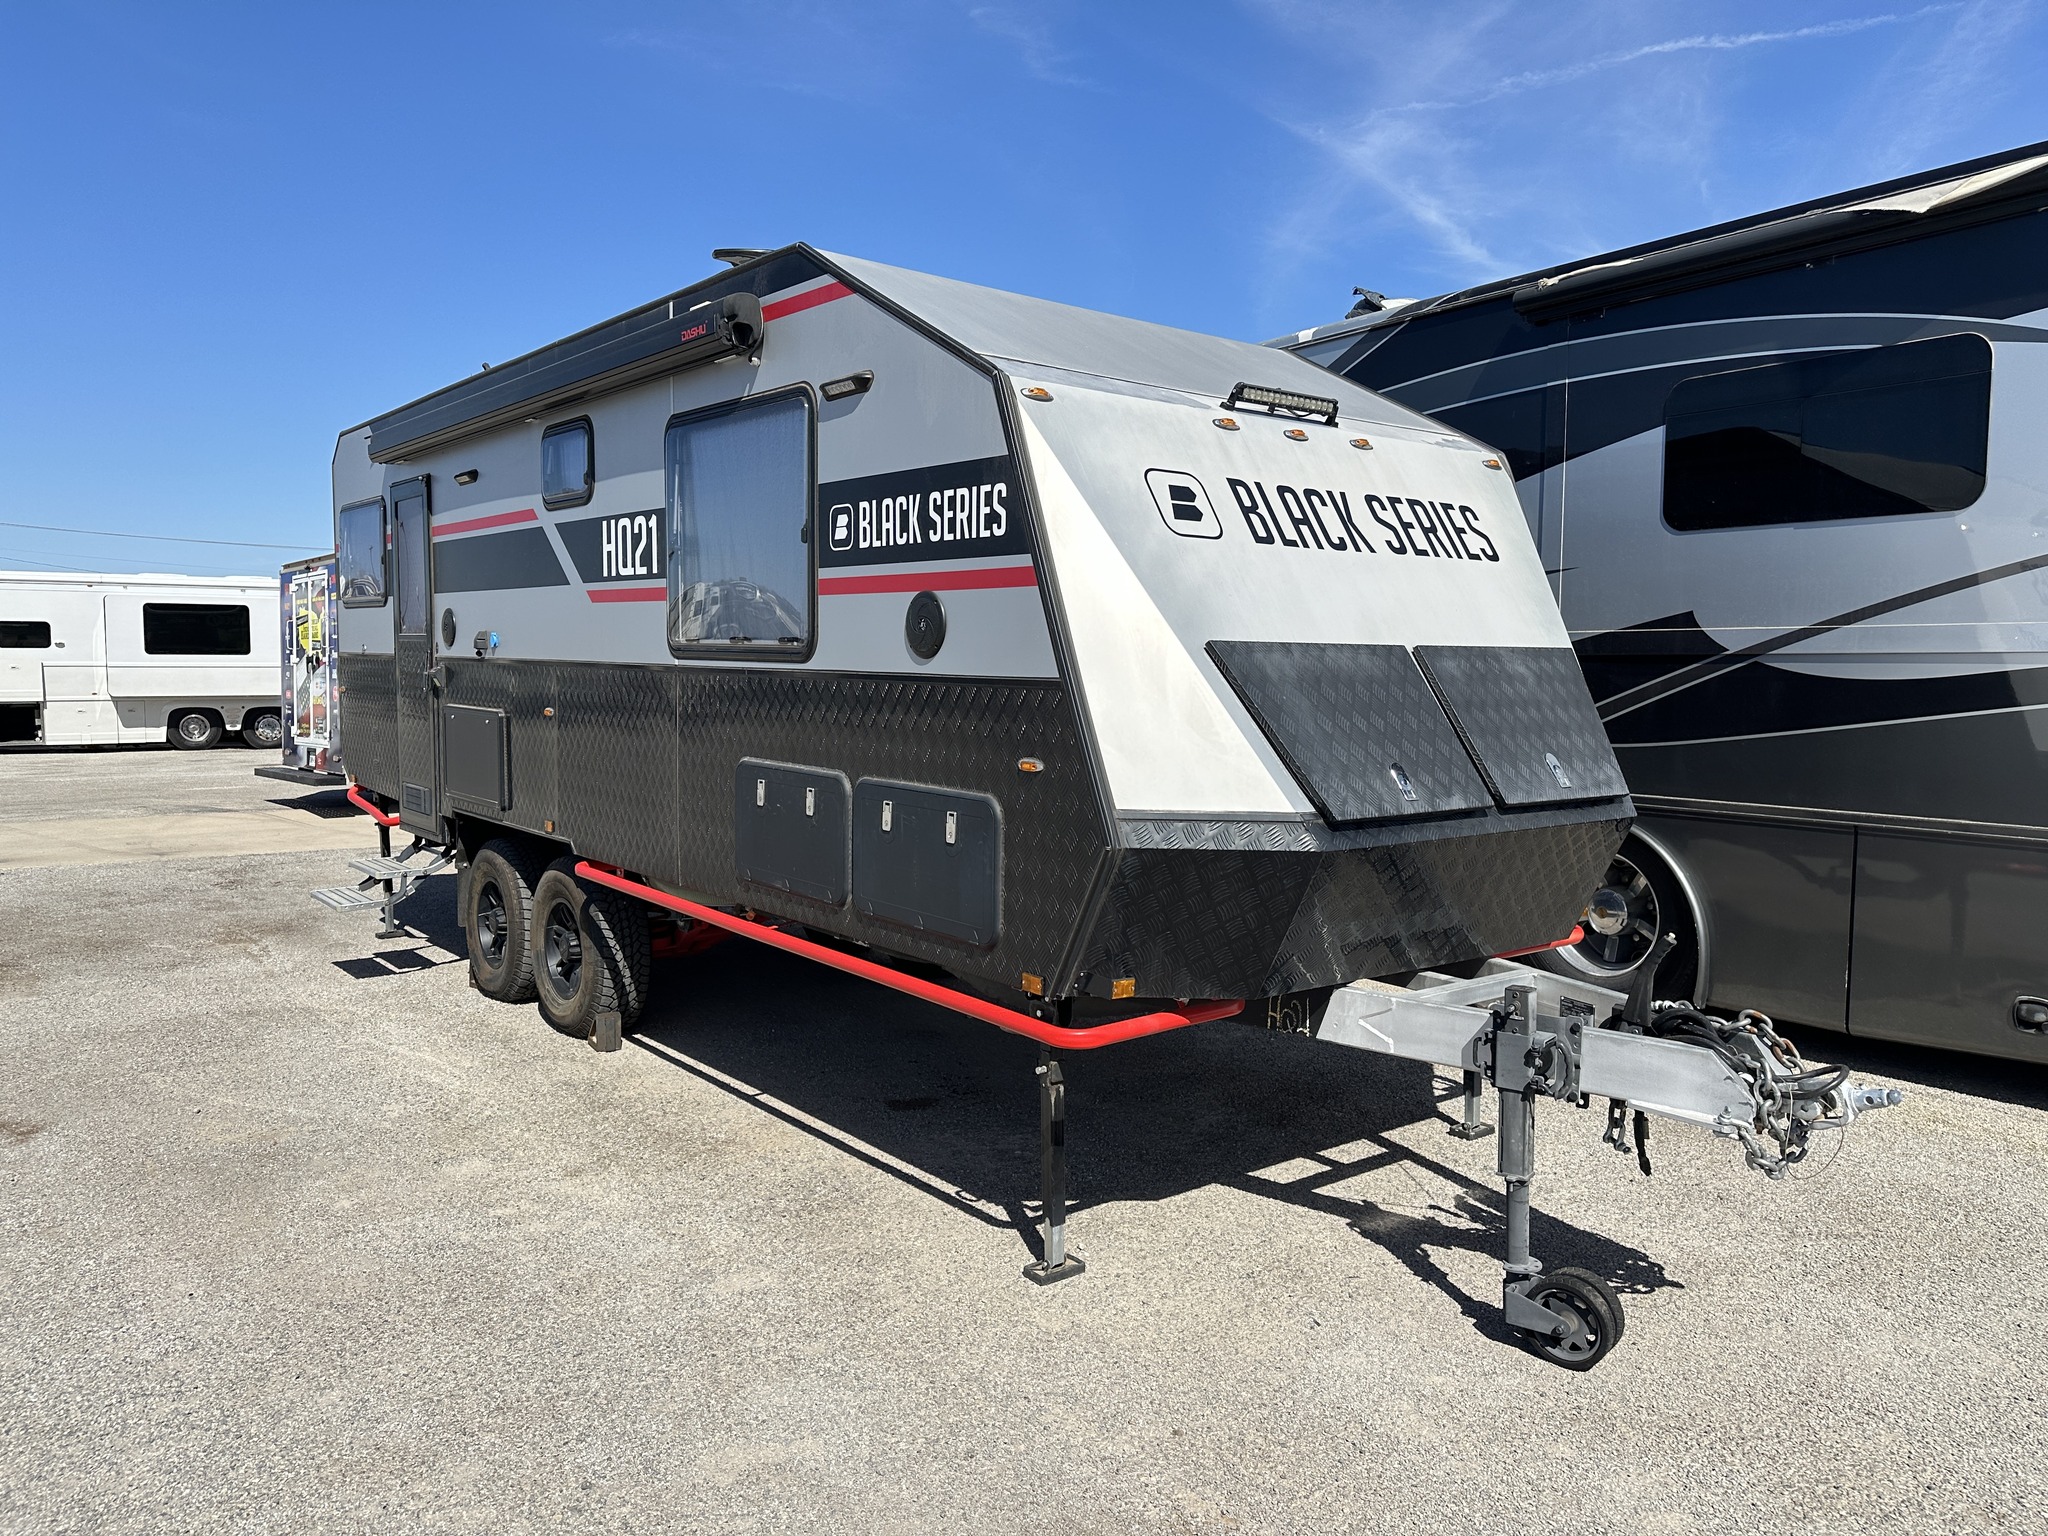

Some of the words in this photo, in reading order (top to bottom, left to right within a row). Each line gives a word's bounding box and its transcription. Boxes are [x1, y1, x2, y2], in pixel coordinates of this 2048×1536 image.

[681, 323, 707, 342] DASHU
[602, 513, 659, 577] HQ21
[858, 493, 922, 550] BLACK
[929, 482, 1007, 543] SERIES
[1226, 477, 1377, 554] BLACK
[1364, 494, 1500, 563] SERIES
